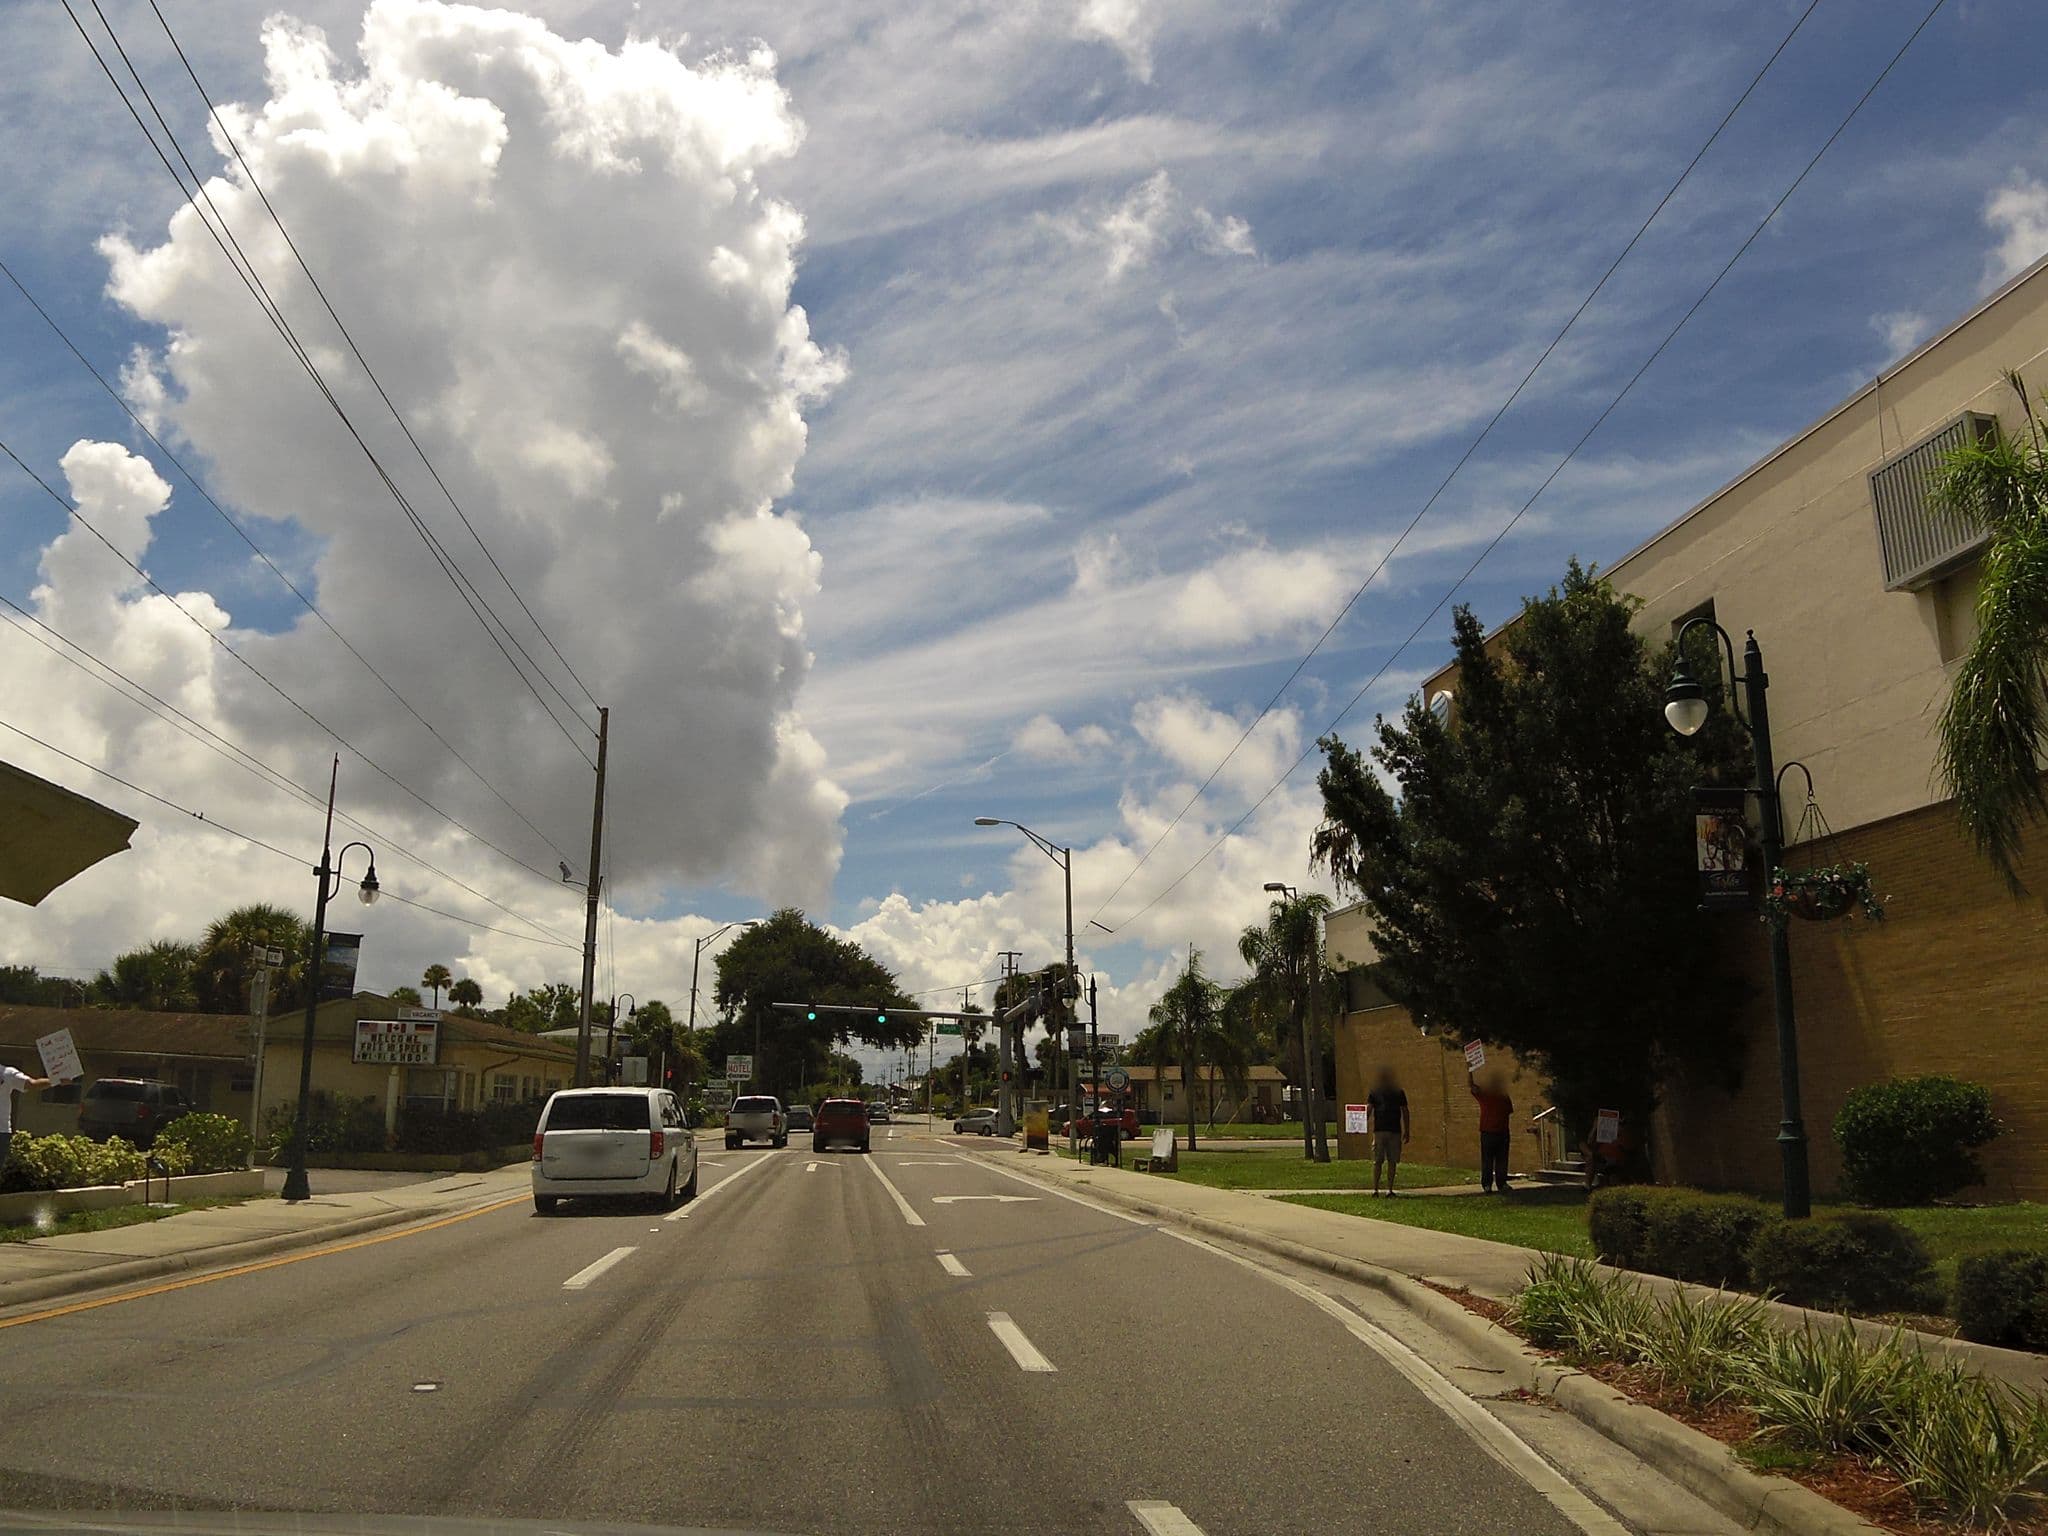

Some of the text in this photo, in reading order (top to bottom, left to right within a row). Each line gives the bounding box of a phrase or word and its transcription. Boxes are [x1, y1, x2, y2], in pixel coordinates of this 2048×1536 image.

[371, 1033, 418, 1043] WELCOME
[361, 1041, 383, 1052] FREE
[399, 1043, 428, 1054] SPEED
[400, 1053, 421, 1062] HBO
[727, 1063, 751, 1073] MOTEL
